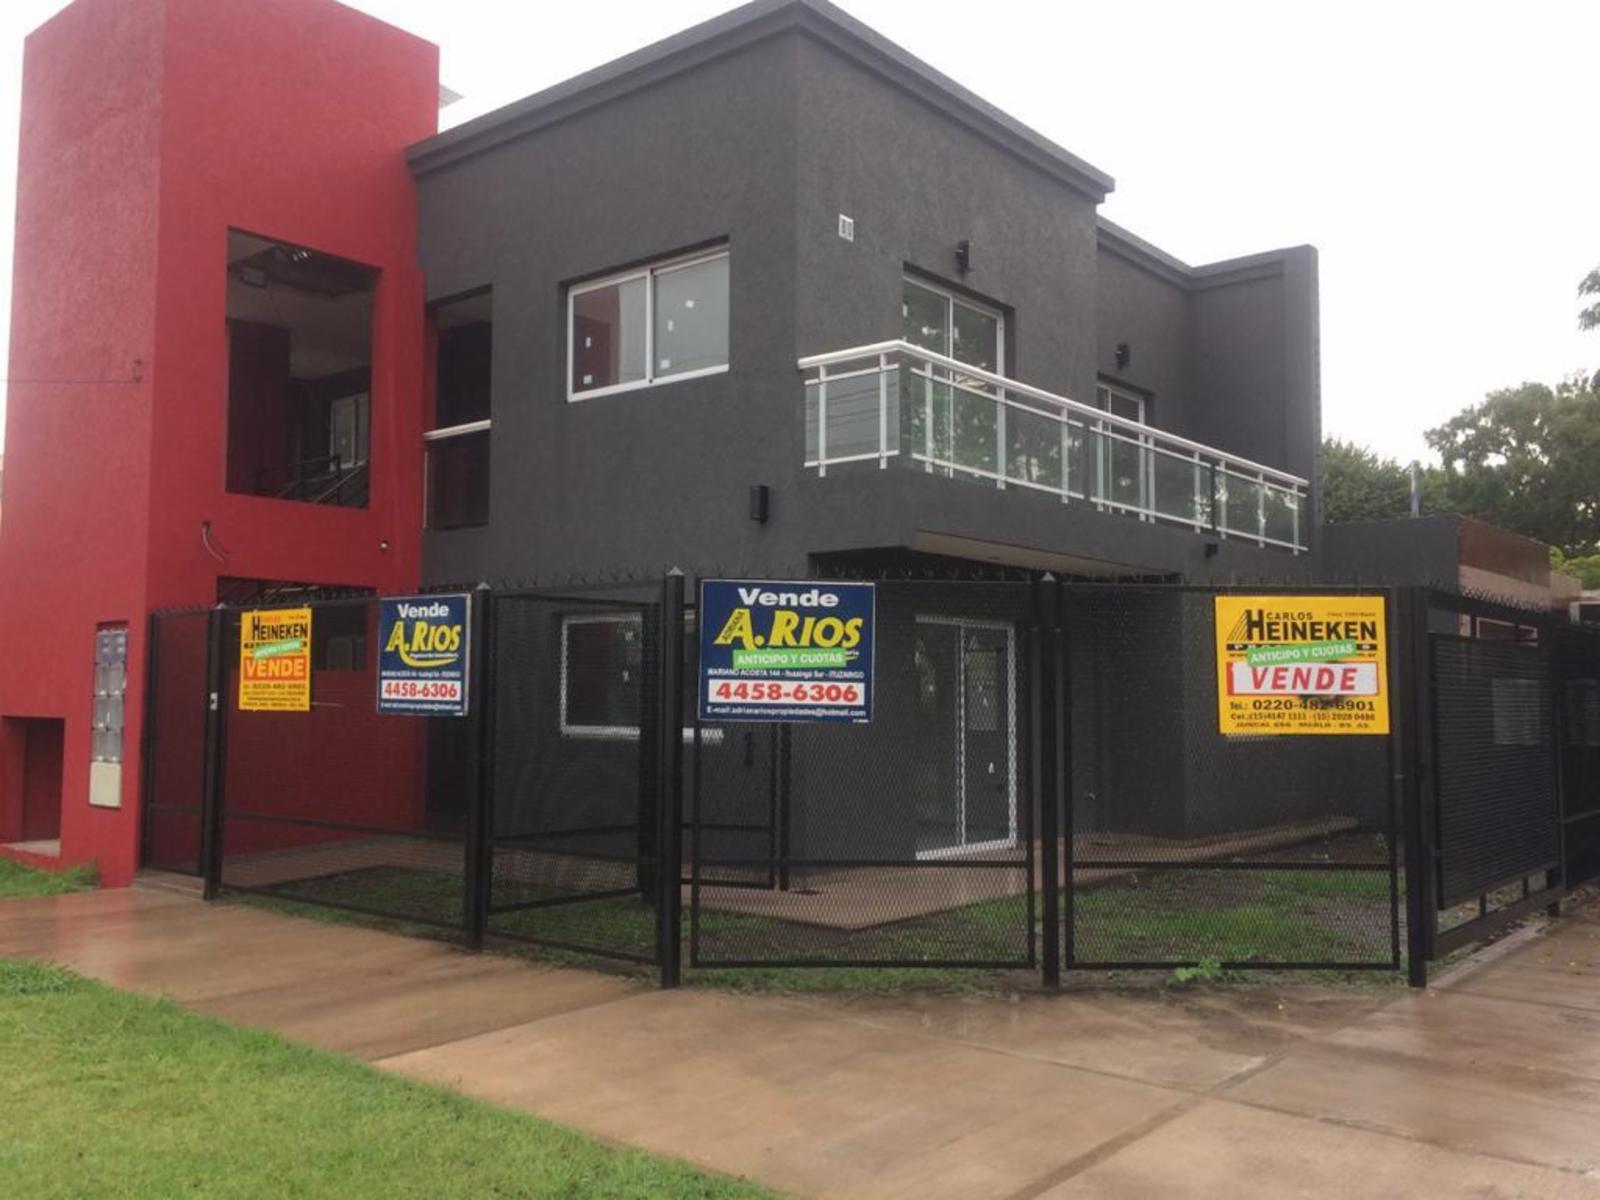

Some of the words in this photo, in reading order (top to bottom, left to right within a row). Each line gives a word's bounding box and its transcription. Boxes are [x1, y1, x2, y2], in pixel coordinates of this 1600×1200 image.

[738, 587, 839, 607] Vende
[397, 602, 449, 618] Vende
[1266, 612, 1313, 620] CARLOS
[252, 616, 308, 640] HEINEKEN
[713, 608, 863, 650] A.RIOS
[1245, 609, 1376, 641] HEINEKEN
[385, 621, 461, 652] A.RIOS
[738, 653, 788, 665] ANTICIPO
[791, 654, 799, 664] Y
[800, 653, 843, 664] CUOTAS
[1250, 648, 1301, 662] ANTICIPO
[1302, 648, 1310, 658] Y
[1311, 643, 1353, 657] CUOTAS
[244, 658, 305, 677] VENDE
[1251, 667, 1358, 691] VENDE
[385, 682, 457, 698] 4458-6306
[716, 682, 859, 702] 4458-6306
